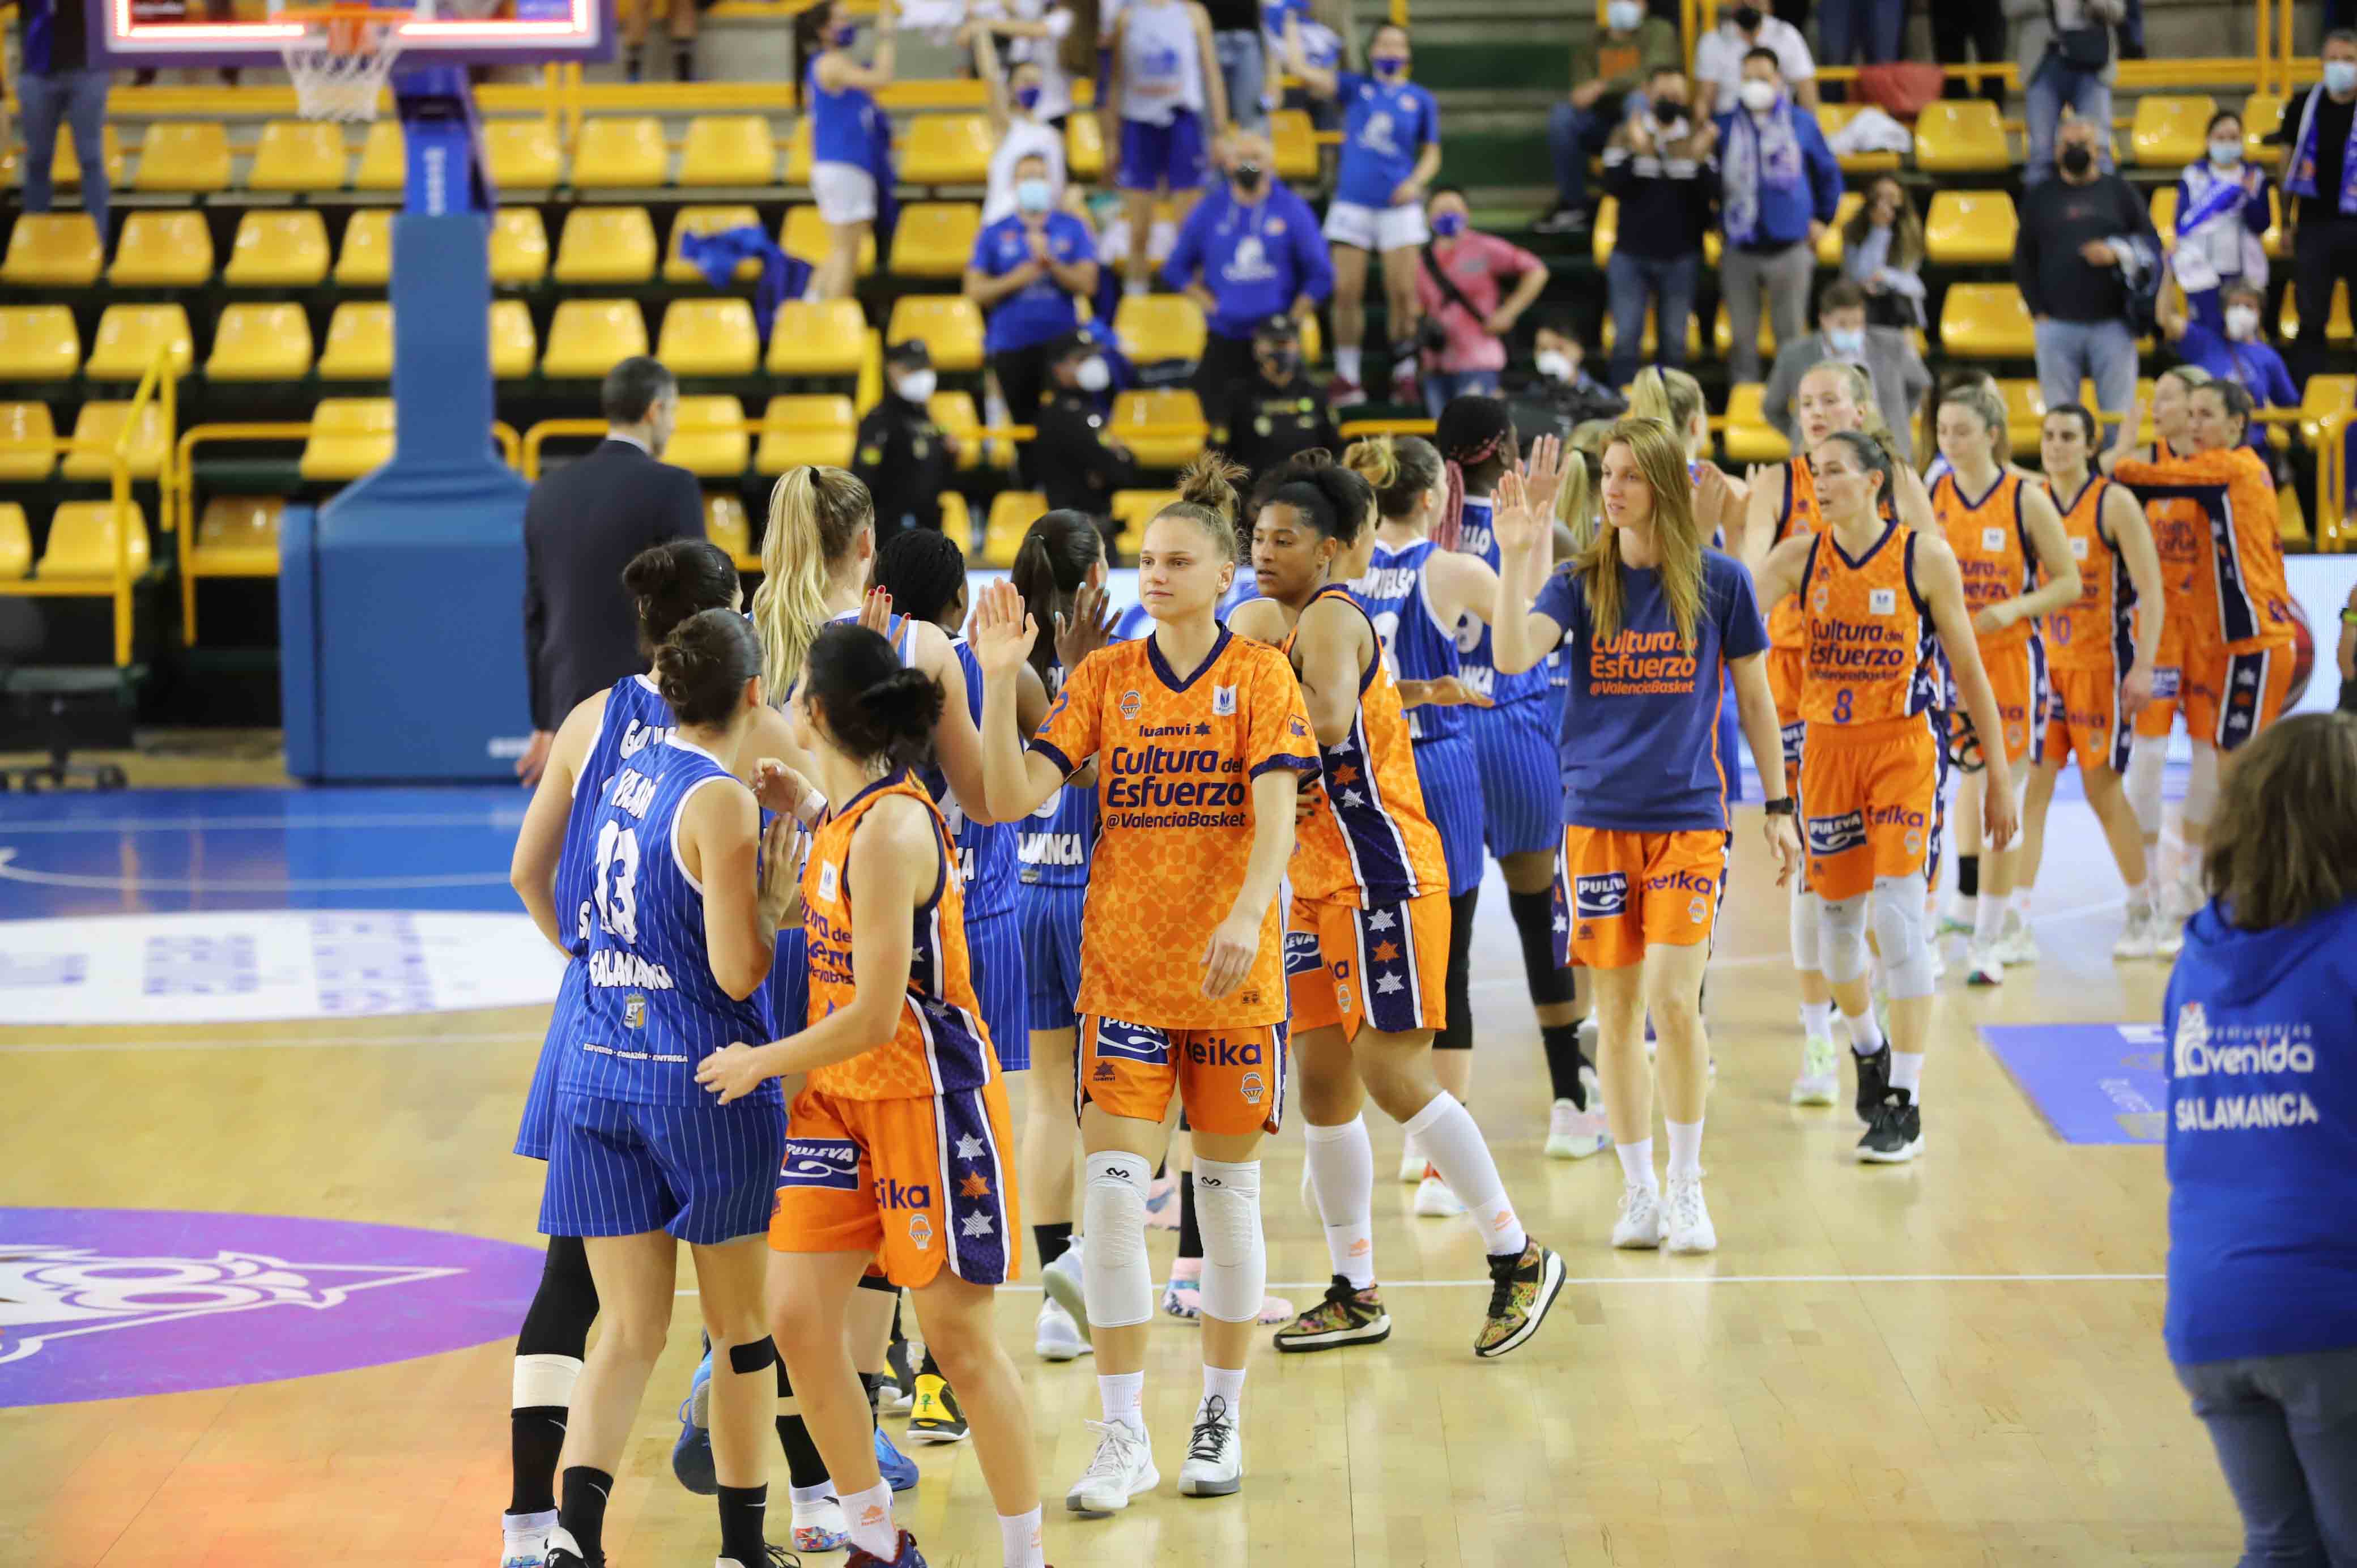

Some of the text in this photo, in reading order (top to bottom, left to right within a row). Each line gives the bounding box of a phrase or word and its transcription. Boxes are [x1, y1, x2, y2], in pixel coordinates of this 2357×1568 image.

[1591, 629, 1677, 654] Cultura
[1812, 619, 1883, 641] Cultura
[1590, 654, 1697, 679] Esfuerzo
[1810, 643, 1904, 666] Esfuerzo
[1832, 689, 1853, 724] 8
[1139, 723, 1190, 737] luanvi
[1111, 745, 1244, 774] Cultura del
[1107, 776, 1246, 808] Esfuerzo
[1107, 811, 1246, 829] @ValenciaBasket
[594, 819, 640, 944] 13
[2176, 1092, 2319, 1131] SALAMANCA
